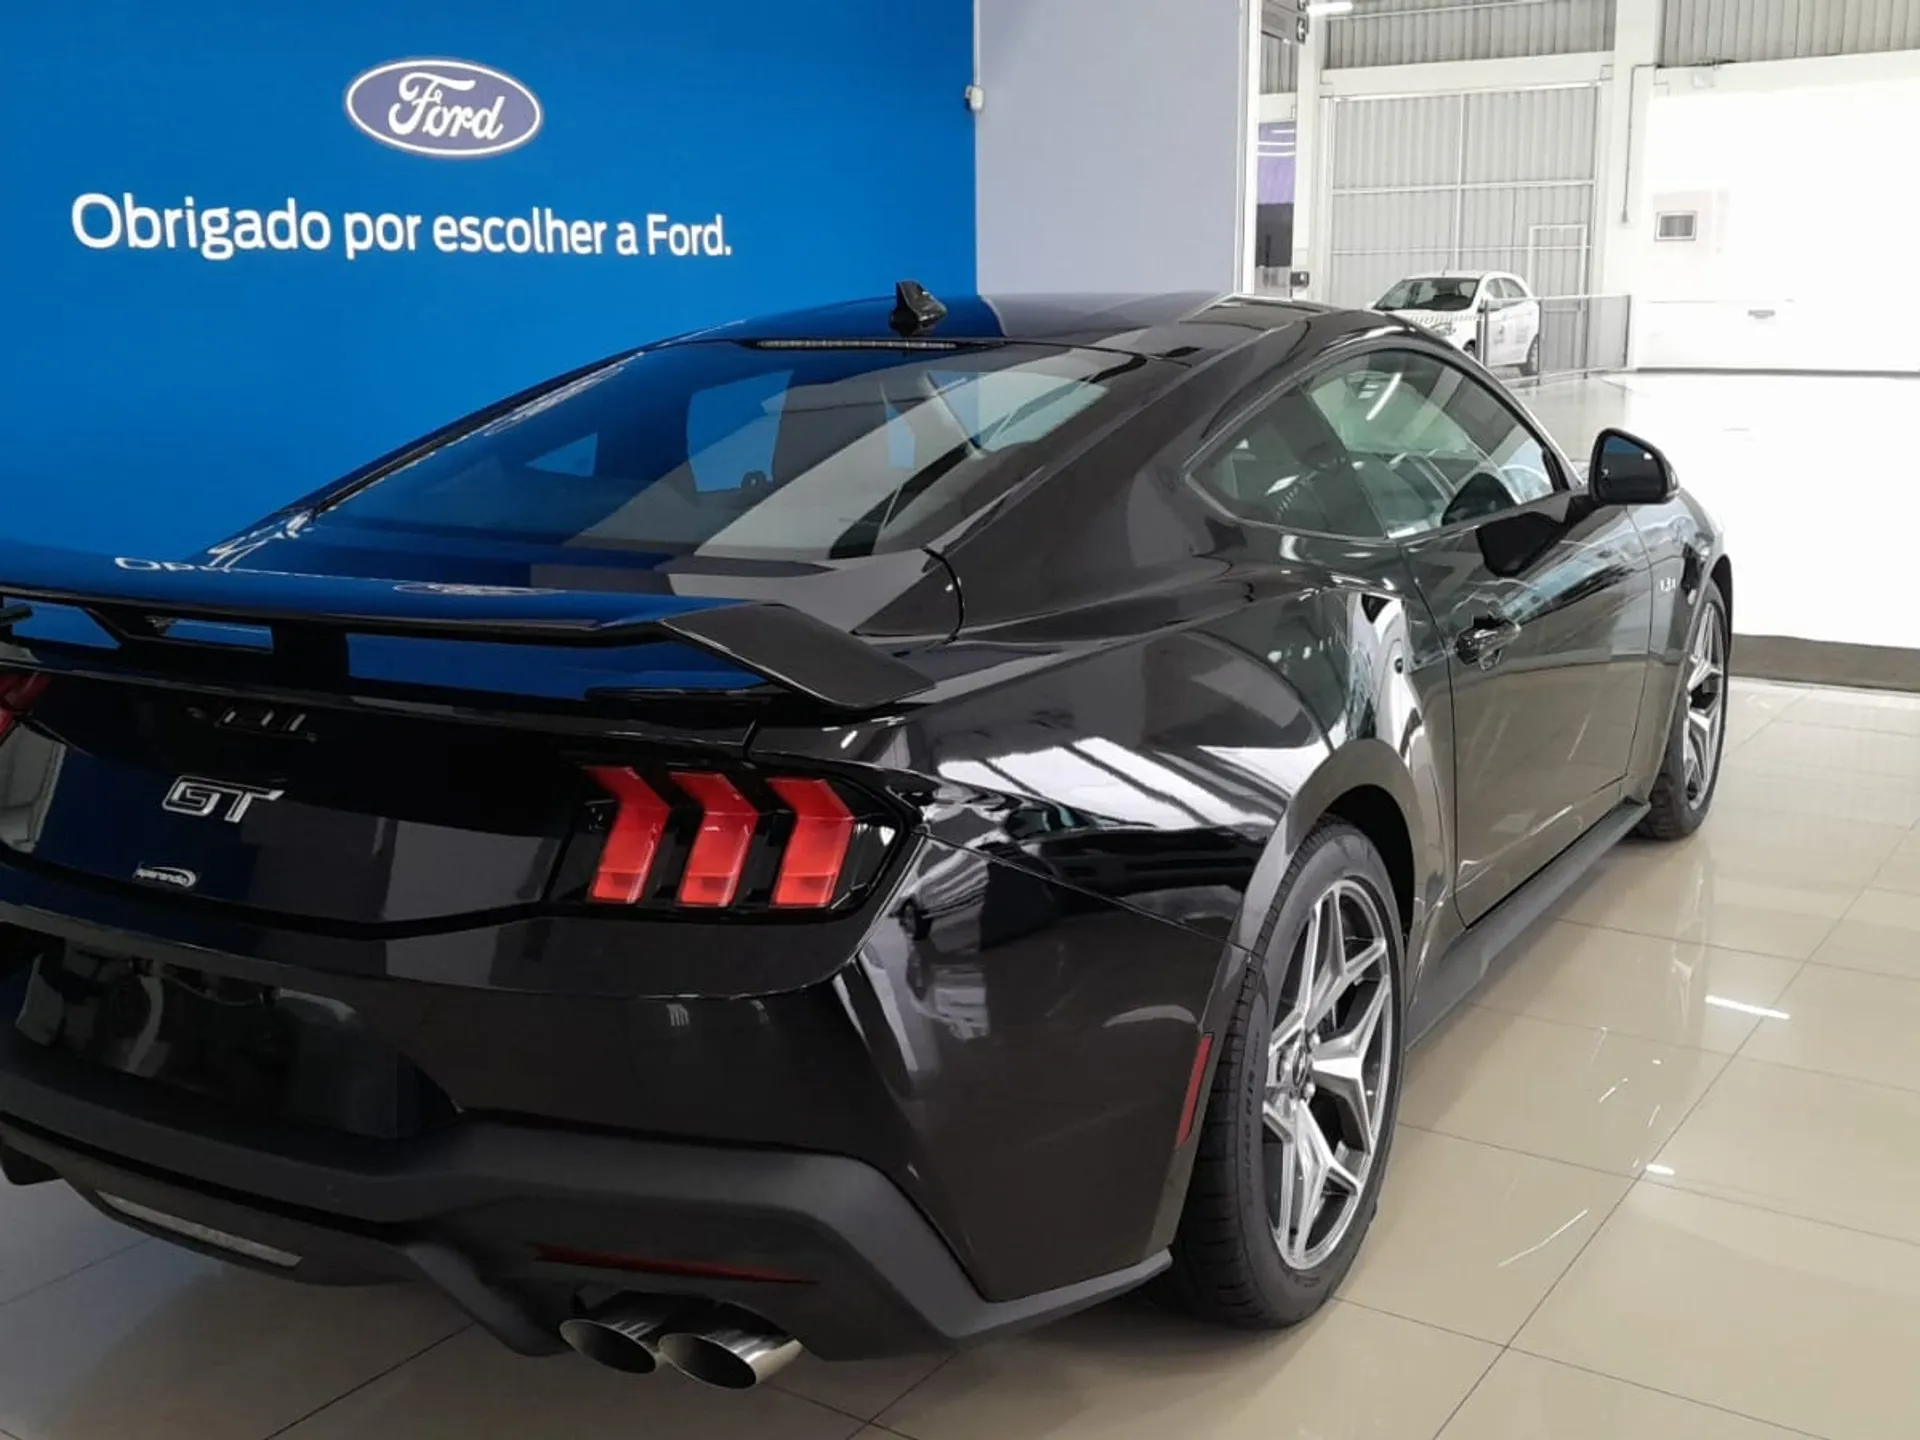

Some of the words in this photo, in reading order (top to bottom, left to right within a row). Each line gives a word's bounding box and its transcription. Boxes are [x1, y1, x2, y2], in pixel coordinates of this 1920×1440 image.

[388, 71, 505, 141] Ford
[71, 192, 331, 260] Obrigado
[344, 211, 421, 260] por
[433, 207, 608, 255] escolher
[615, 221, 640, 256] a
[646, 212, 732, 257] Ford.
[161, 774, 286, 824] GT
